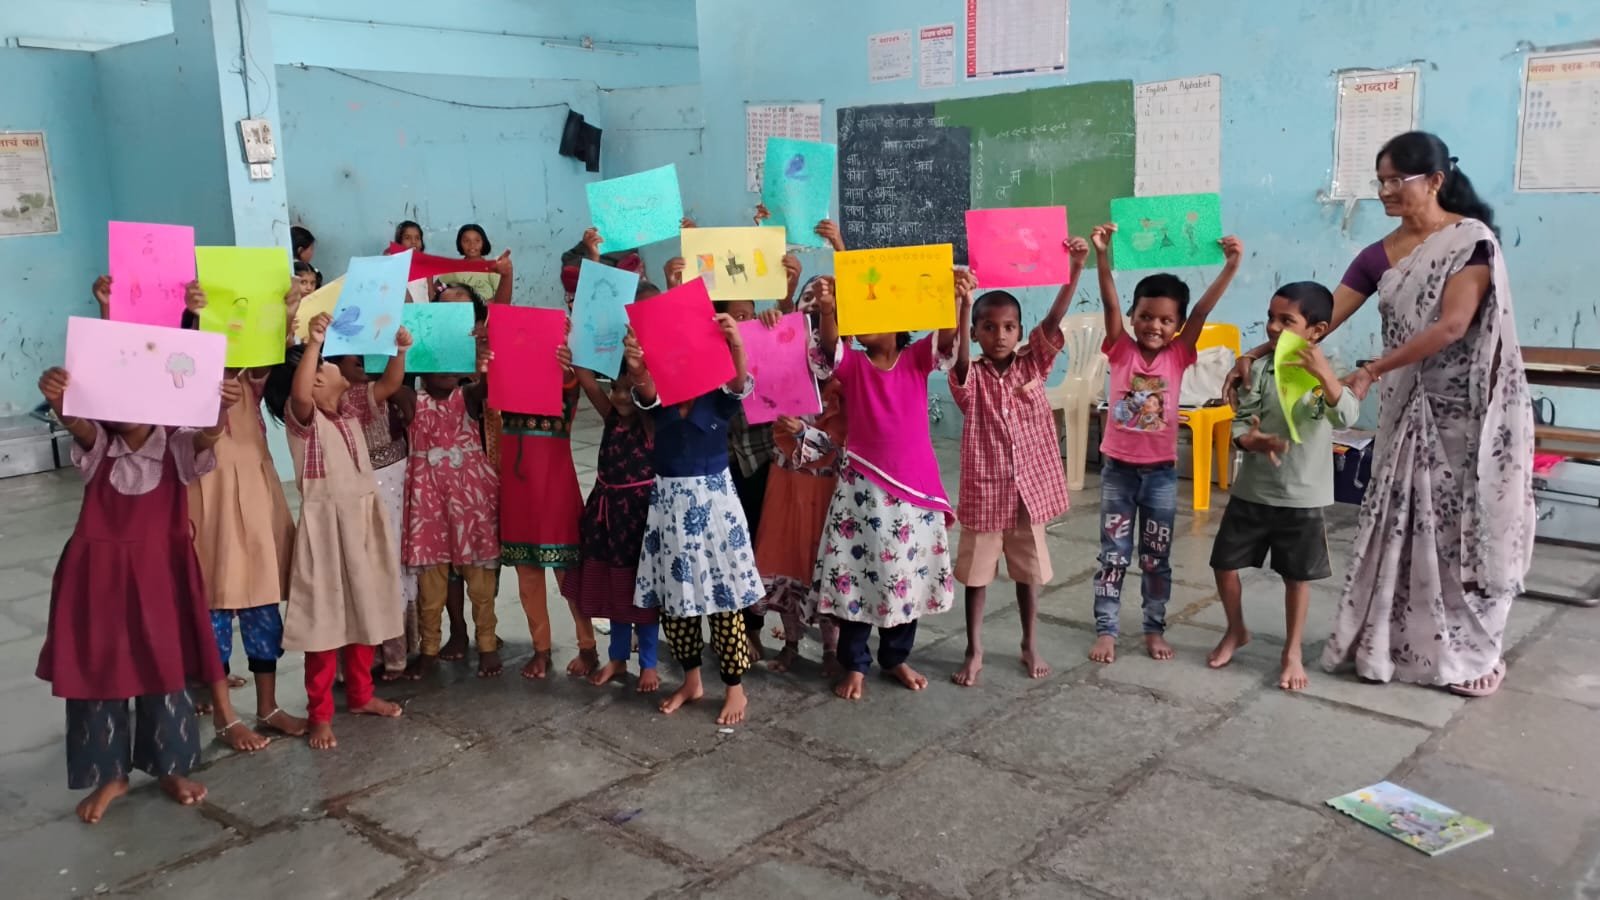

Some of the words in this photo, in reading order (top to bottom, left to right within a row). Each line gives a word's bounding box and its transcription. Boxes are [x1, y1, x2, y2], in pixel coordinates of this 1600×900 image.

[1146, 84, 1168, 96] English
[1179, 79, 1211, 92] Alphabet
[1354, 78, 1401, 93] शब्दार्थ
